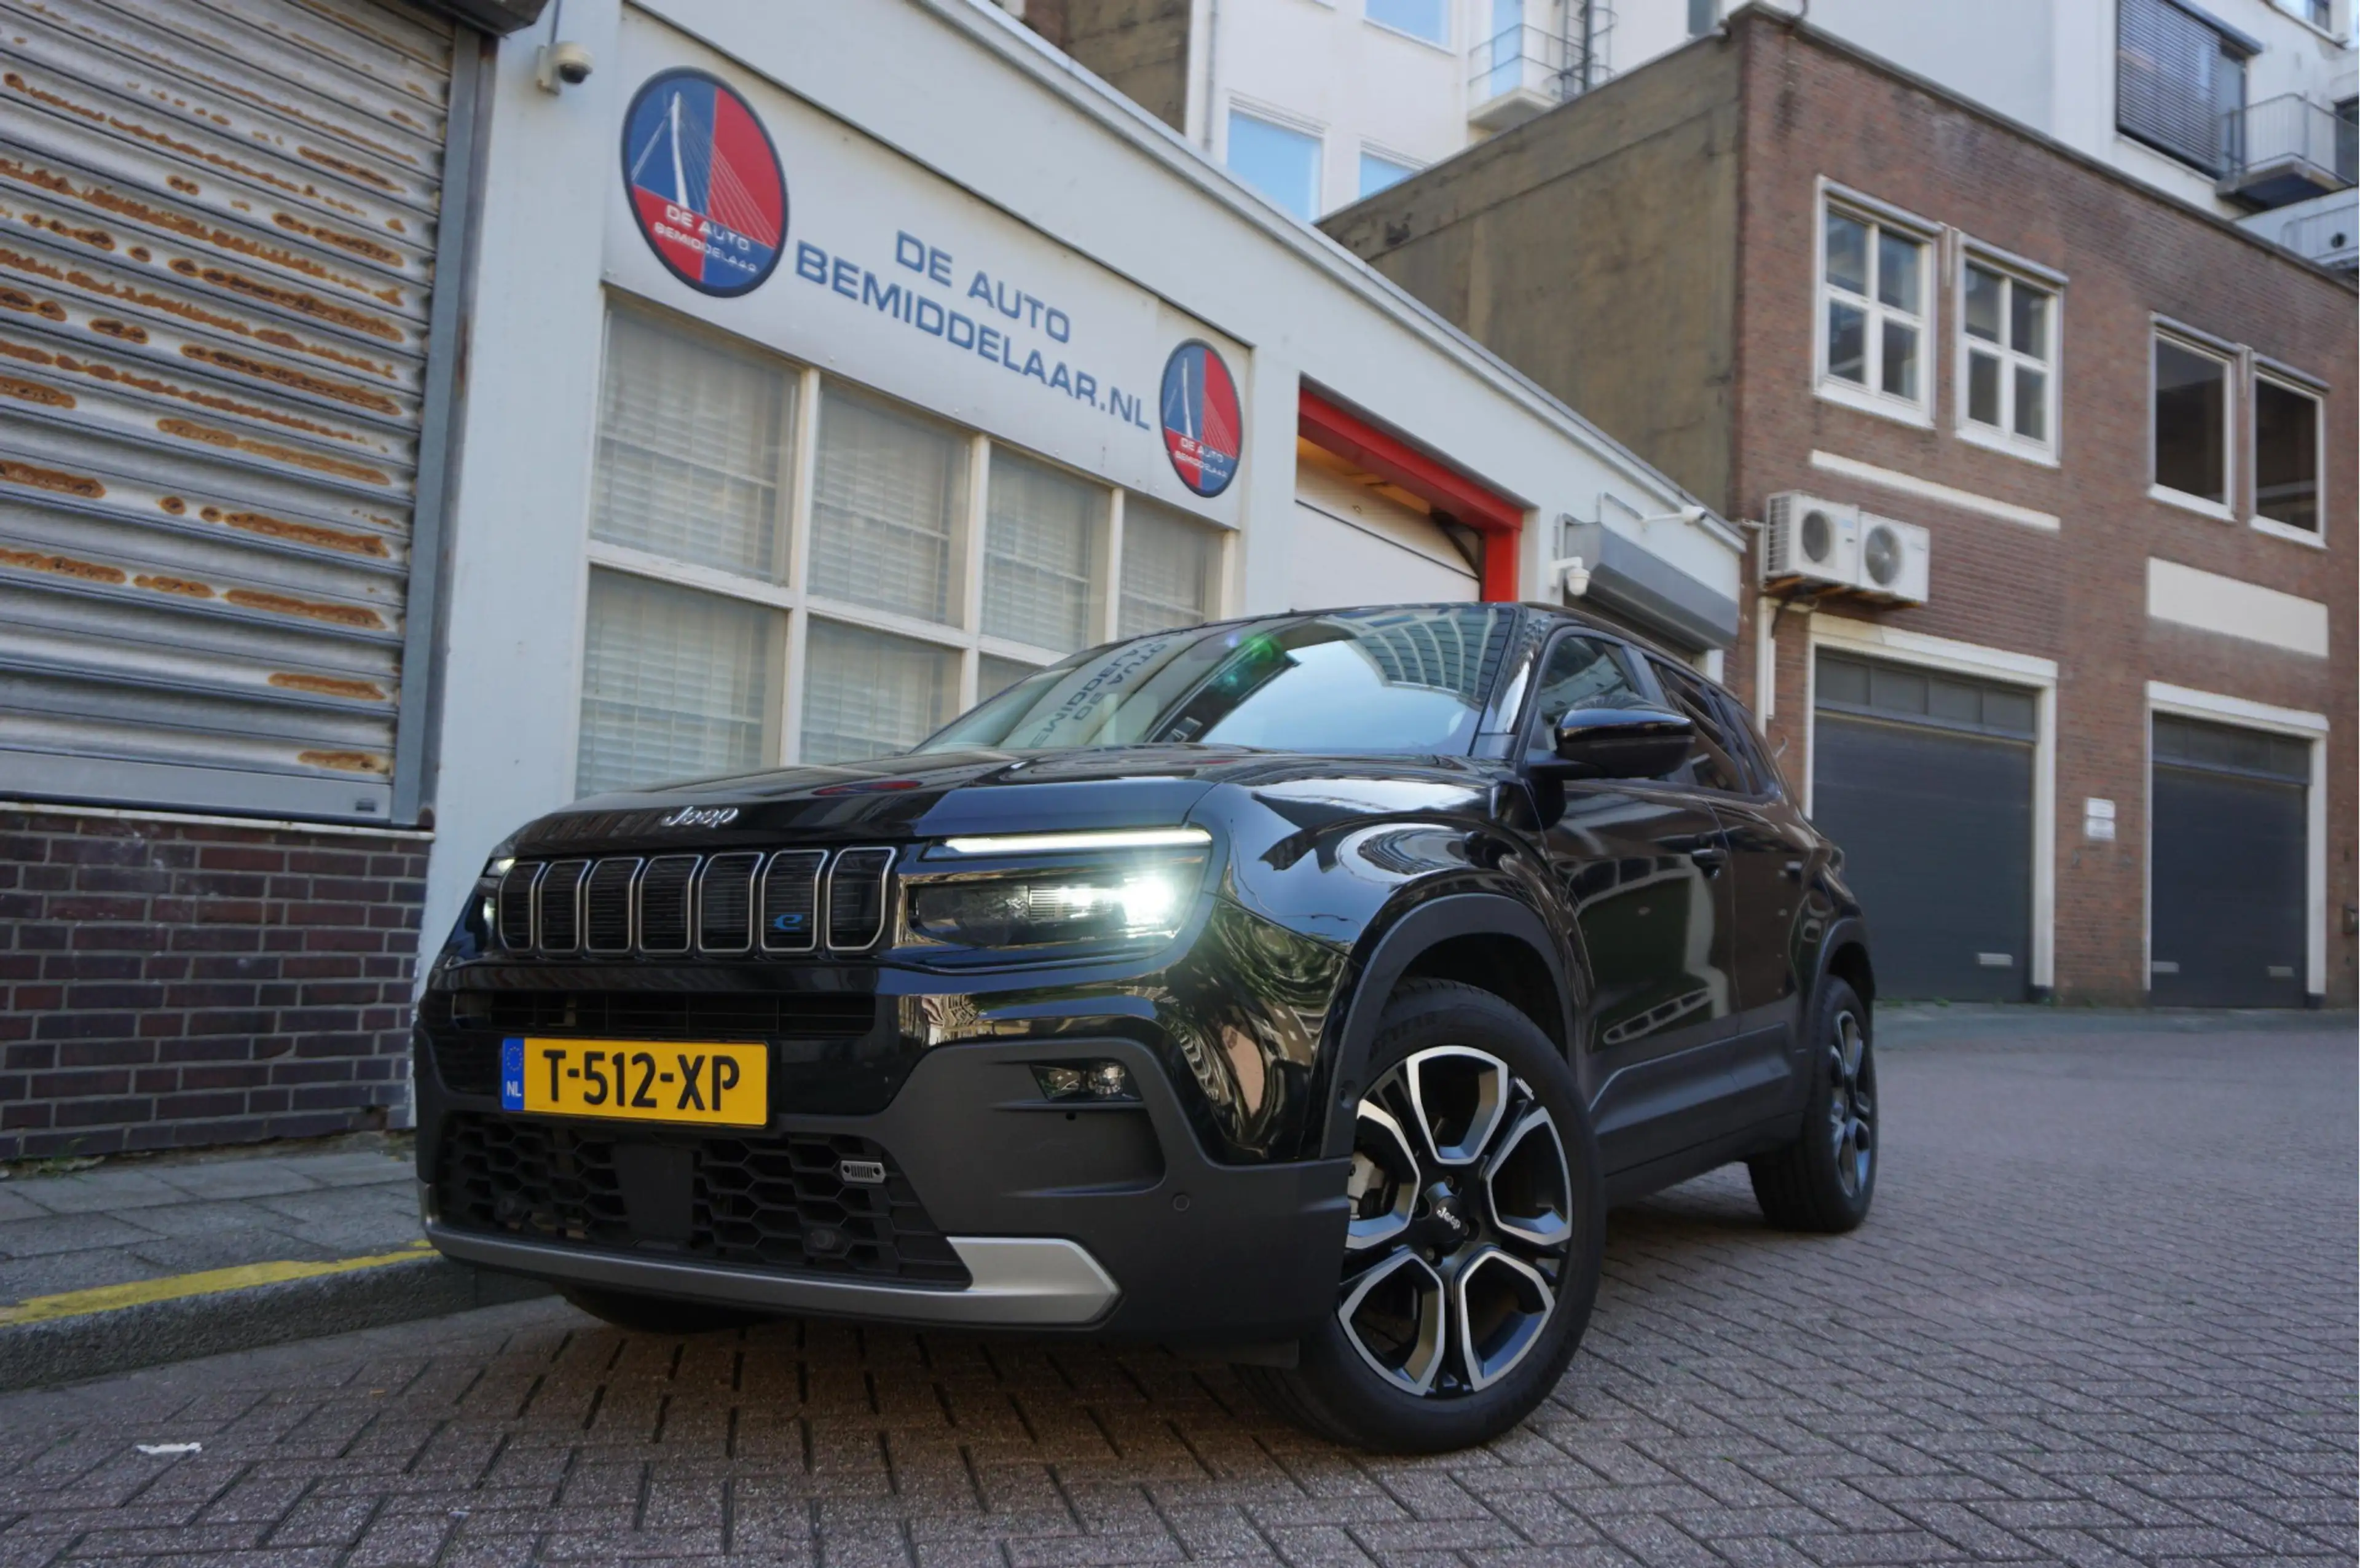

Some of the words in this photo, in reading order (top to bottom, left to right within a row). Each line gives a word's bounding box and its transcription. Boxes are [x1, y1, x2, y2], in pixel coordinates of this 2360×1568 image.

[654, 222, 758, 273] BEMIDDELAAR
[665, 204, 693, 228] DE
[698, 221, 751, 252] AUTO
[895, 230, 953, 288] DE
[967, 270, 1070, 343] AUTO
[795, 239, 1150, 431] BEMIDDELAAR.NL
[1180, 437, 1195, 451] DE
[661, 806, 739, 828] Jeep
[506, 1080, 522, 1098] NL
[543, 1049, 740, 1111] T-512-XP
[1436, 1206, 1461, 1229] Jeep
